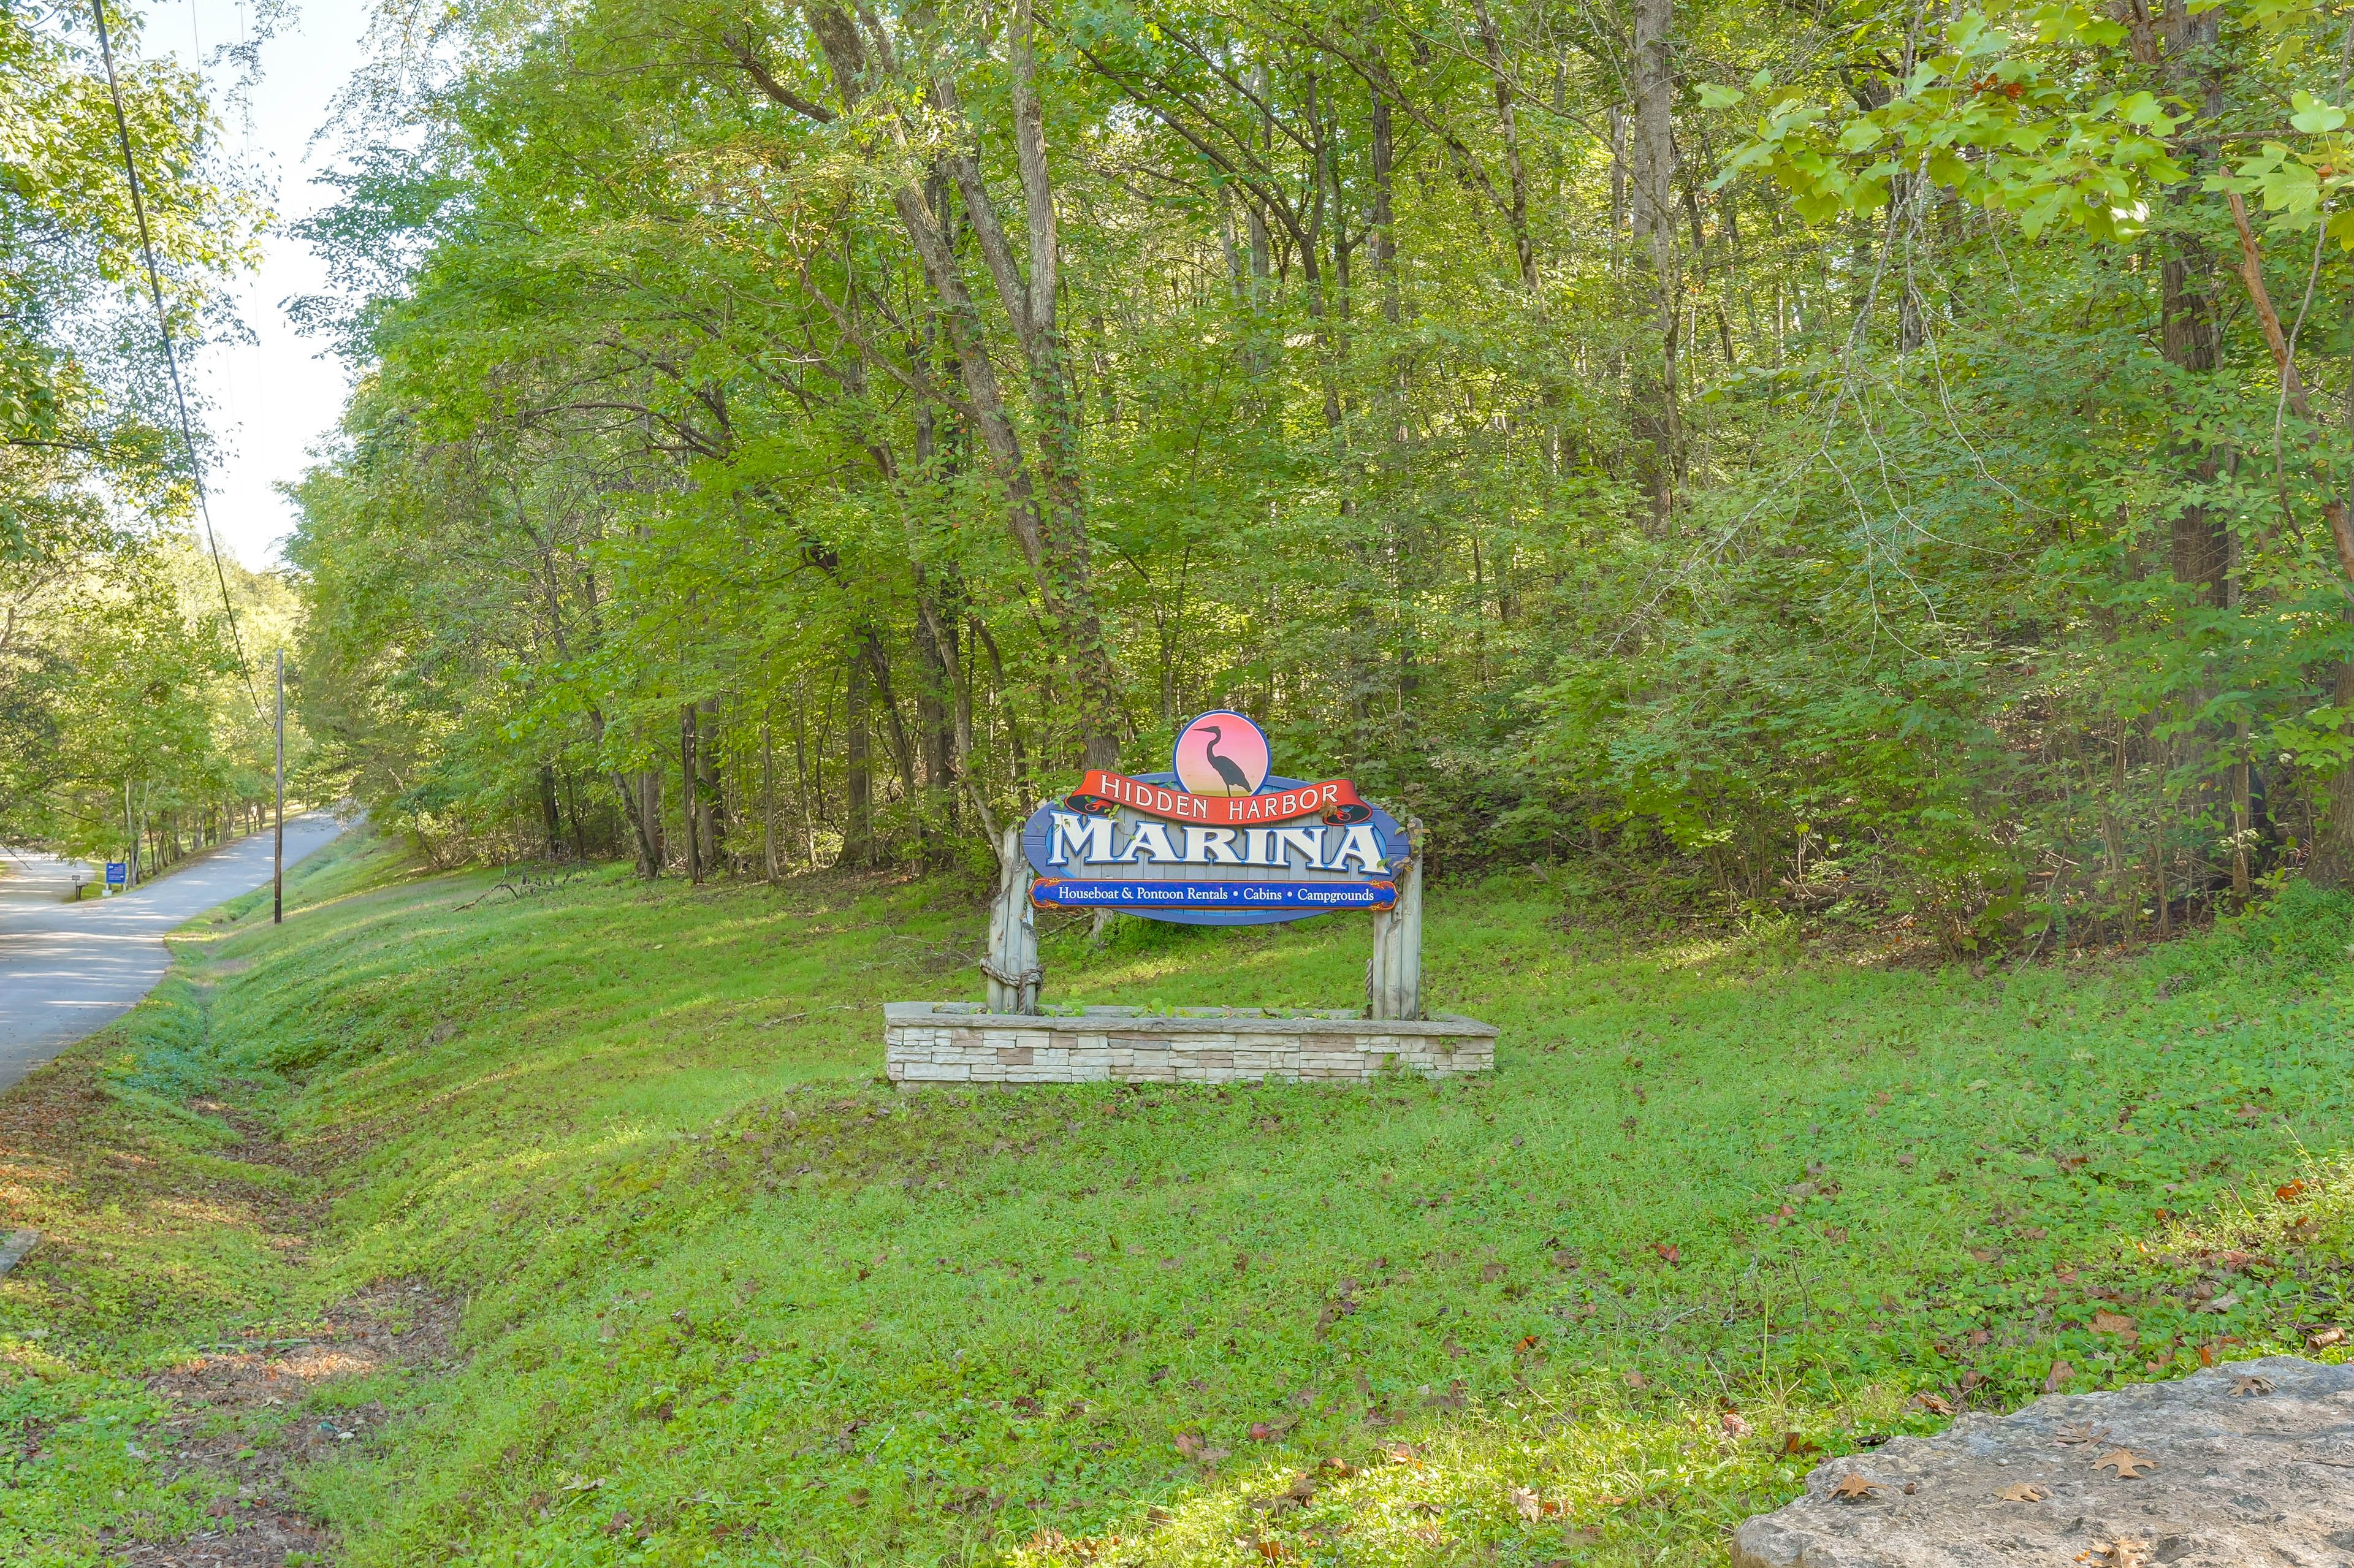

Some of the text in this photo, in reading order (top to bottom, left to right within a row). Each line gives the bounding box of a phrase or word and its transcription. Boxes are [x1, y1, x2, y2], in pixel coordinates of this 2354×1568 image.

[1100, 774, 1338, 820] HIDDEN HARBOR
[1047, 809, 1392, 875] MARINA
[1059, 887, 1374, 903] Houseboat & Pontoon Rentals Cabins Campgrounds
